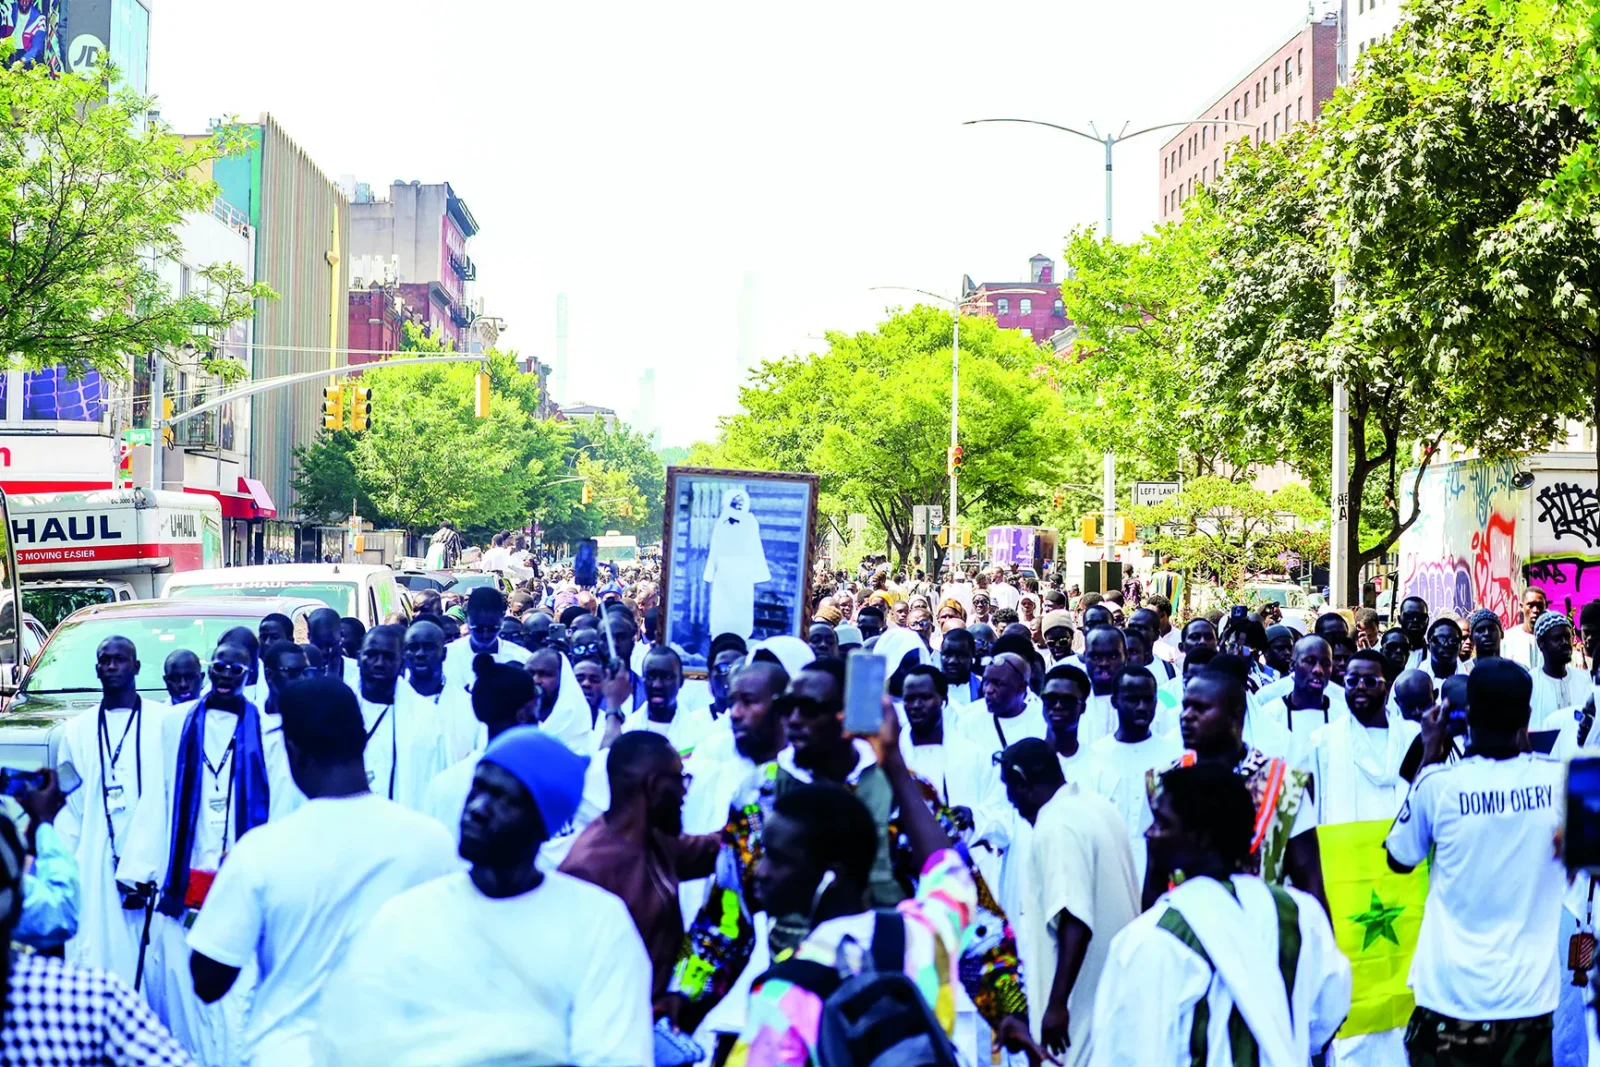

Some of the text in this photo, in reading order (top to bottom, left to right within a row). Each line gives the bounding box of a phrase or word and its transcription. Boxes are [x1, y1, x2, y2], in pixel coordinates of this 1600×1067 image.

[1140, 487, 1156, 496] LEFT
[25, 551, 63, 562] MOVING
[63, 549, 96, 560] EASIER
[1458, 791, 1506, 817] DOMU
